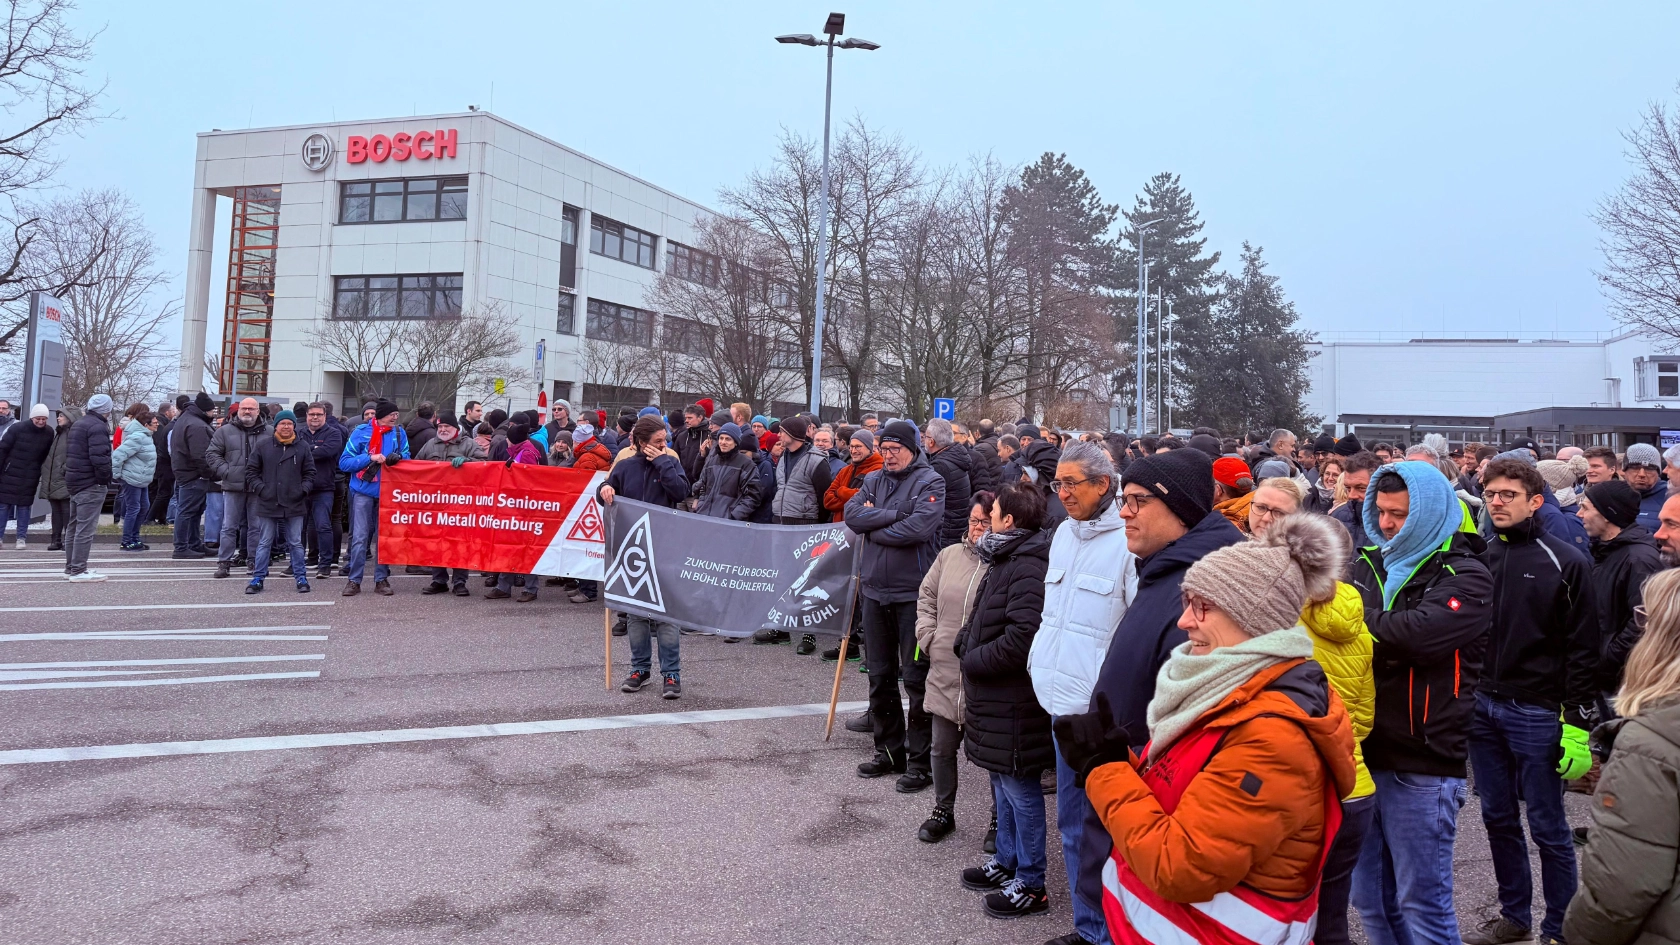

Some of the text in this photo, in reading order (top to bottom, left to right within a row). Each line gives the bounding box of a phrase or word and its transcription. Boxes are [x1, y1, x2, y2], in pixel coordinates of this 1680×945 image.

[347, 128, 458, 163] BOSCH
[939, 401, 950, 418] P
[392, 489, 561, 512] Seniorinnen und Senioren
[390, 510, 545, 535] der IG Metall Offenburg
[588, 550, 605, 559] Offen
[793, 528, 851, 559] BOSCH BLBT
[684, 556, 779, 579] ZUKUNFT FÜR BOSCH
[680, 569, 775, 593] IN BÜHL & BÜHLERTAL
[783, 614, 799, 628] IN
[802, 603, 840, 627] BÜHL
